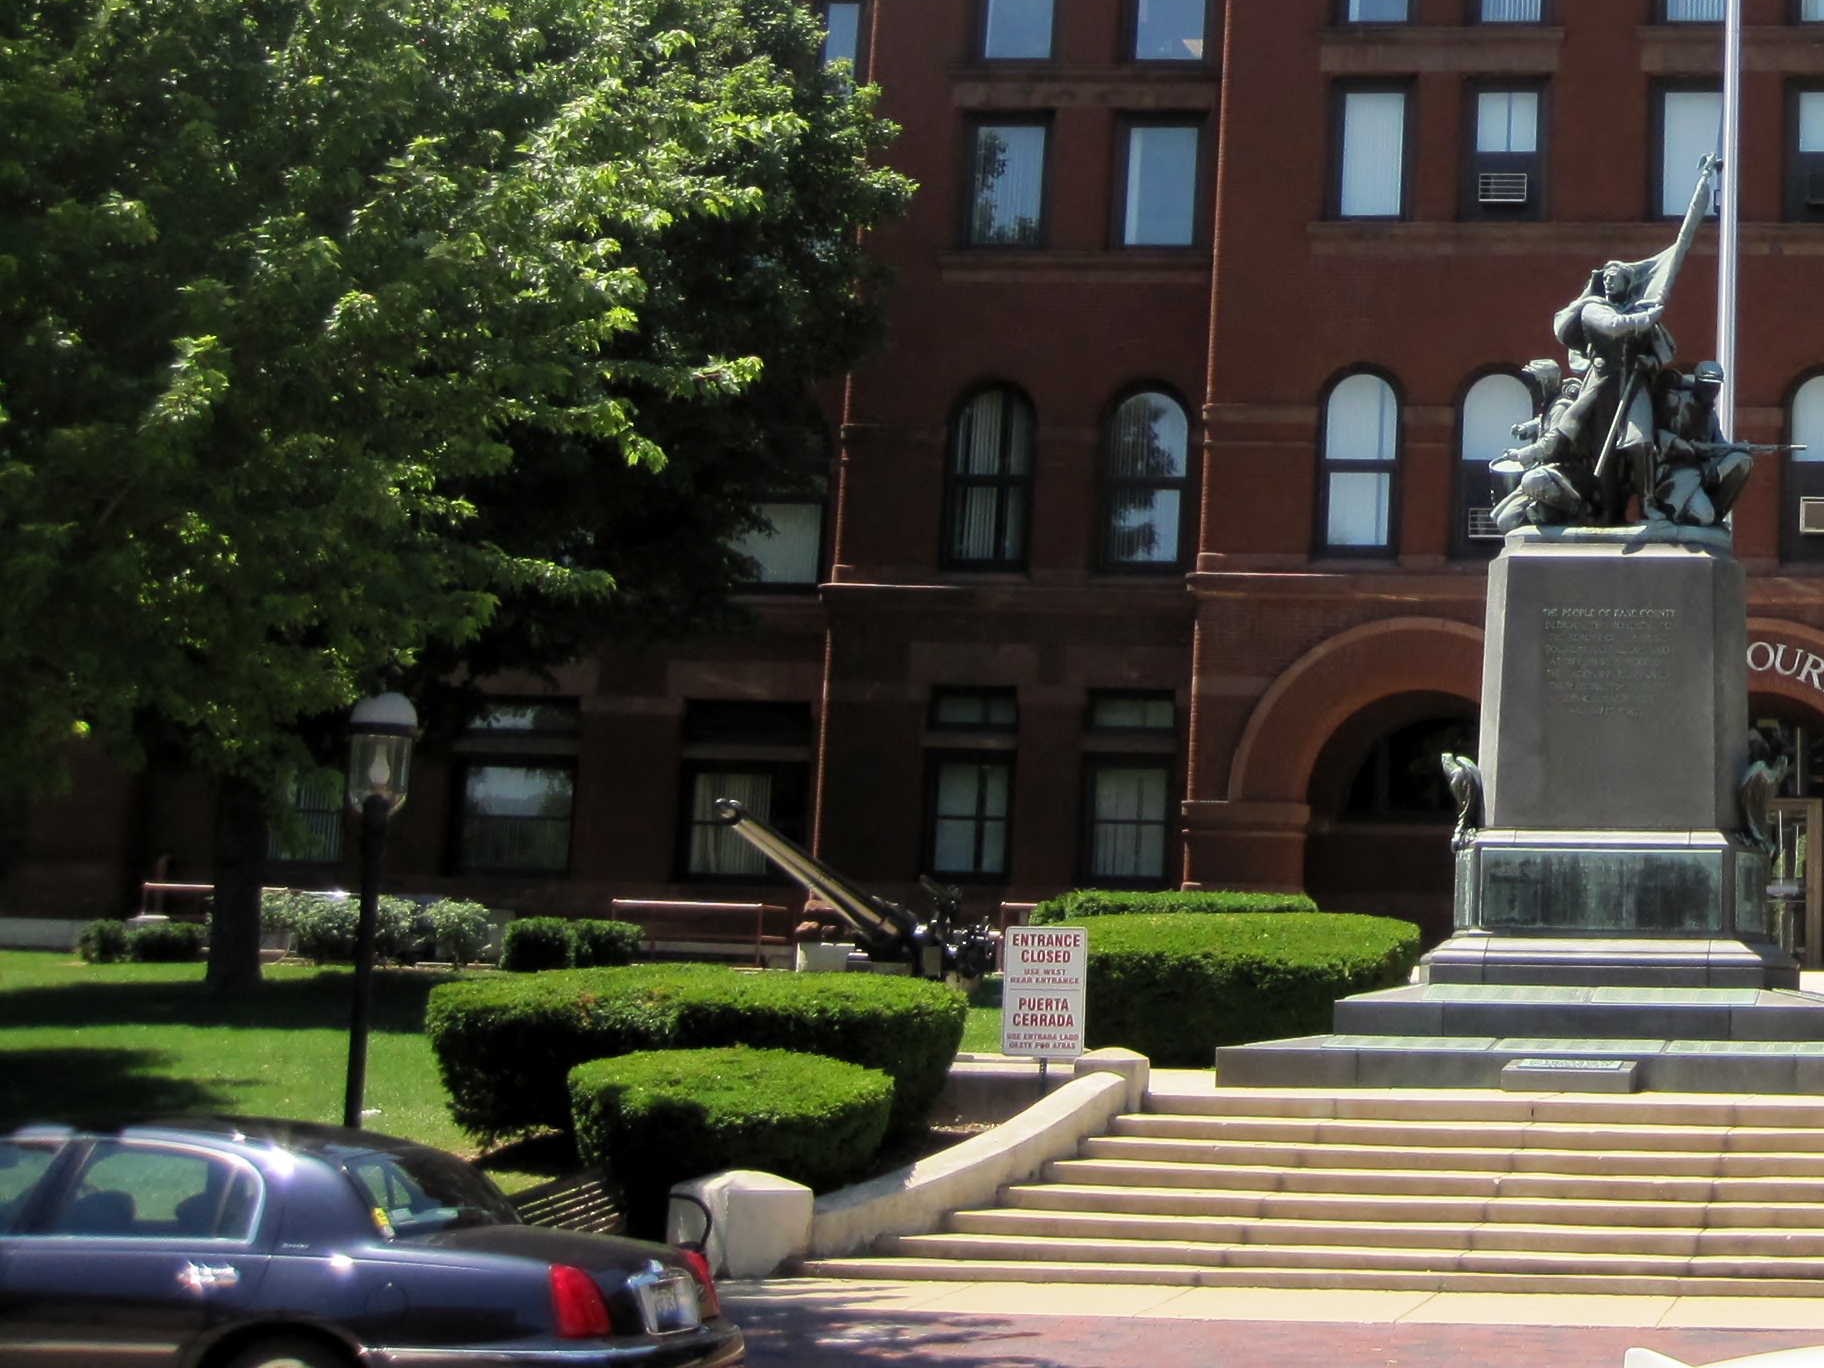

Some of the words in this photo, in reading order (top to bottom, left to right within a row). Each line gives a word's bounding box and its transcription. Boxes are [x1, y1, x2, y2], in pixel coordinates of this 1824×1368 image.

[1012, 933, 1081, 947] ENTRANCE
[1021, 950, 1071, 963] CLOSED
[1018, 997, 1069, 1011] PUERTA
[1012, 1013, 1074, 1027] CERRADA
